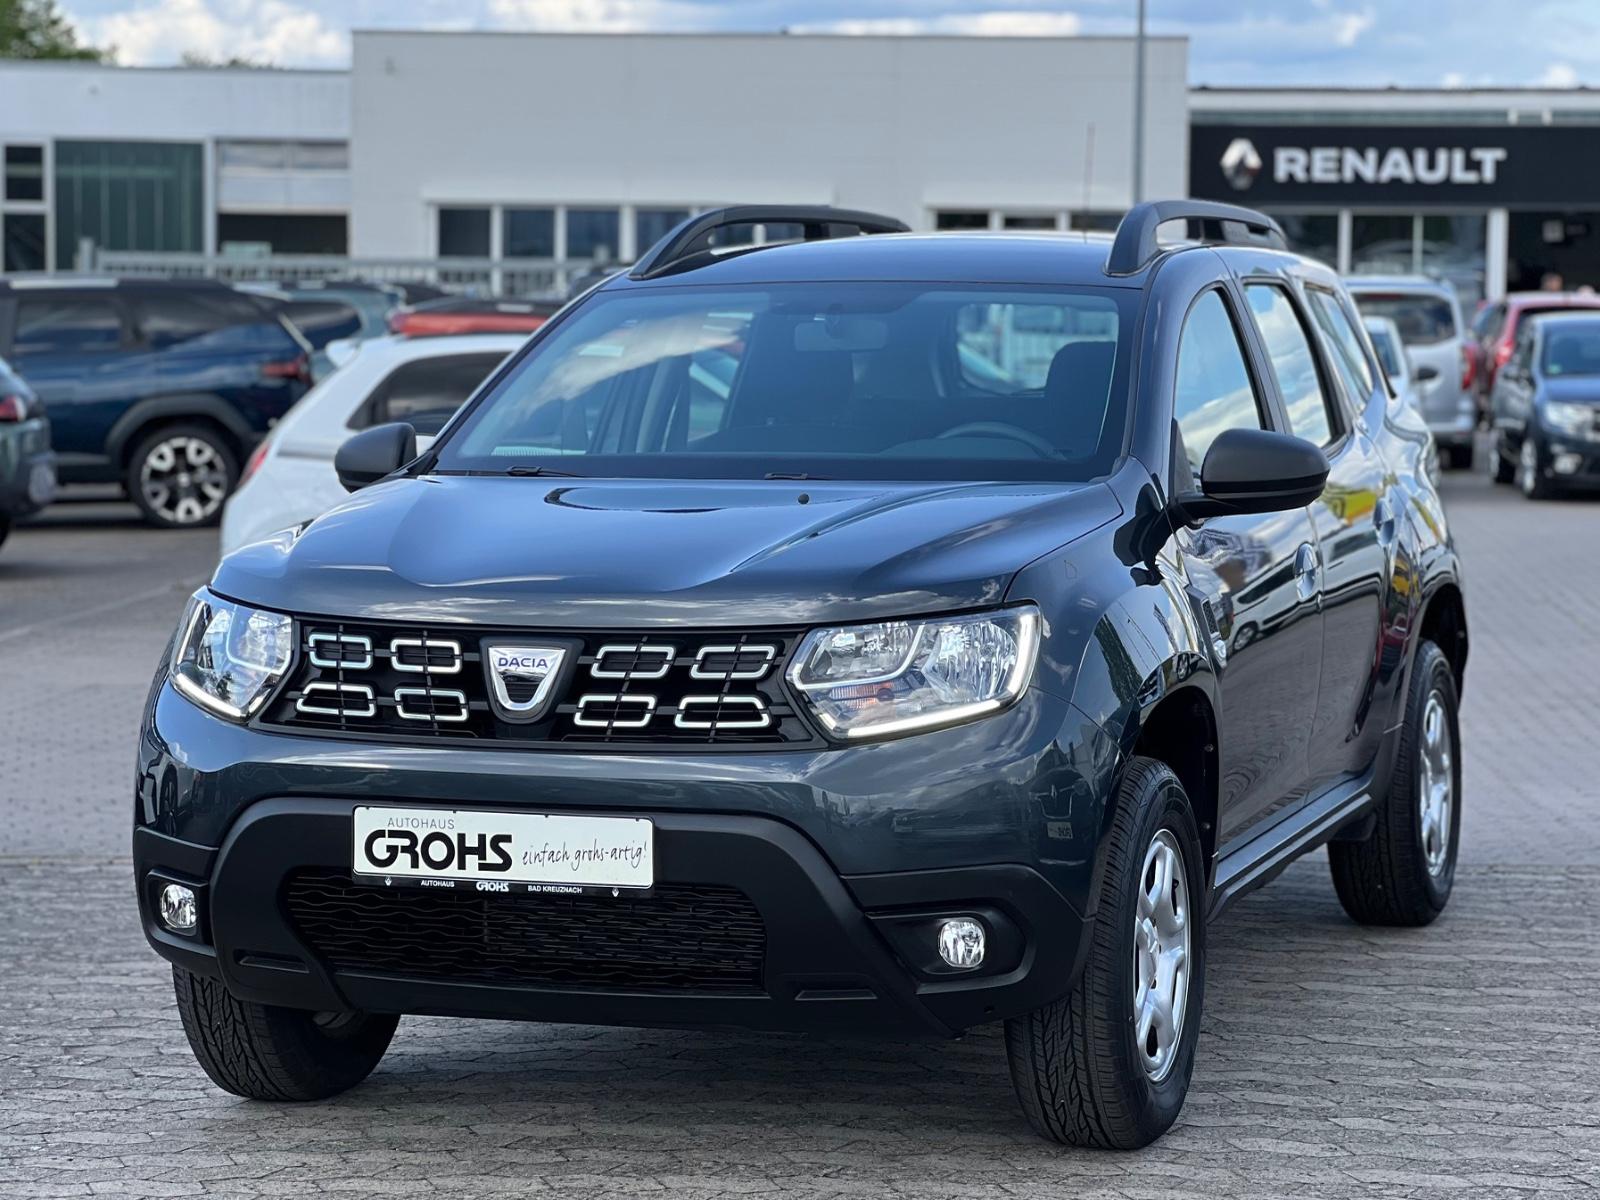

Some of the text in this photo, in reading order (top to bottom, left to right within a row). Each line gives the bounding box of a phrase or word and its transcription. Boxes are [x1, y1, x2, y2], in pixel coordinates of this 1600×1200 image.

[1273, 147, 1508, 184] RENAULT
[498, 657, 548, 668] DACIA
[387, 817, 455, 830] AUTOHAUS
[364, 829, 513, 872] GROHS
[522, 841, 570, 867] einfach
[420, 880, 455, 888] AUTOHAUS
[476, 881, 509, 892] GROHS
[542, 885, 583, 894] KREUZNACH
